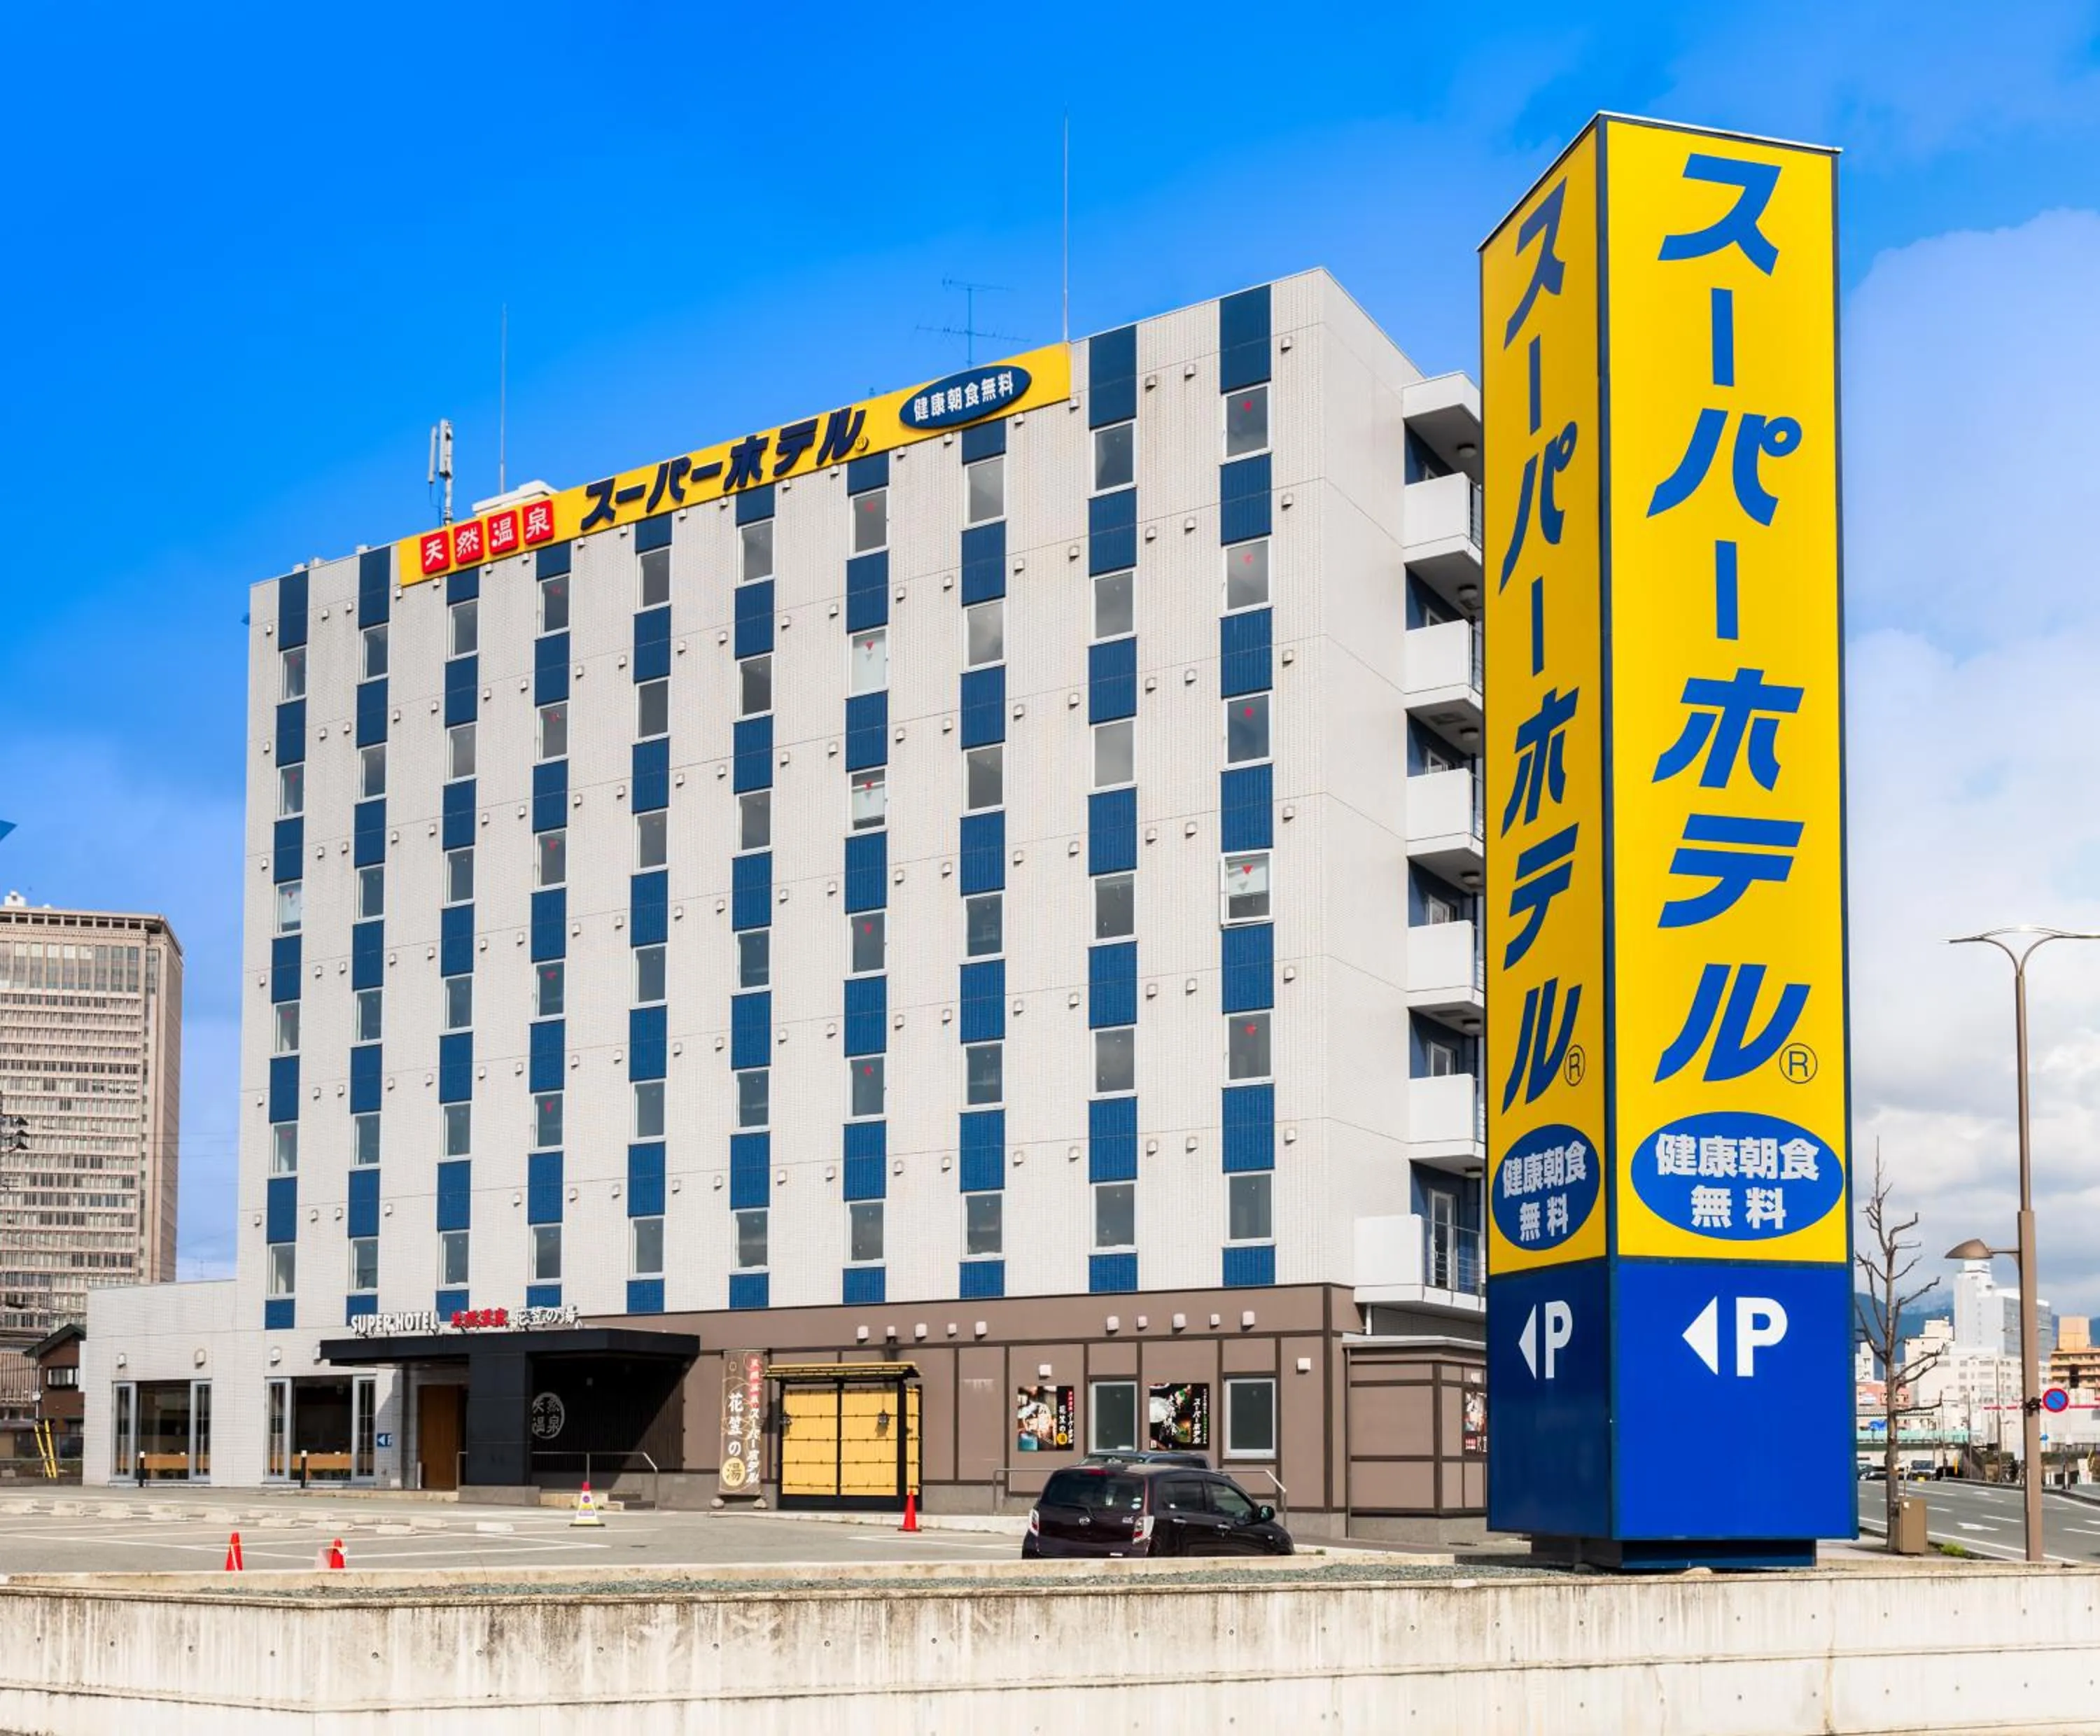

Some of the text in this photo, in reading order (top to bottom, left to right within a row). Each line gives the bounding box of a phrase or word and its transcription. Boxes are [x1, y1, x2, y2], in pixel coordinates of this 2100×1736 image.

[913, 370, 1014, 422] 健康朝食無料
[580, 406, 867, 531] スーパーホテル
[424, 506, 551, 567] 天然温泉
[1499, 176, 1583, 1116] スーパーホテル
[1646, 153, 1812, 1084] スーパーホテル
[1502, 1140, 1588, 1199] 健康朝食
[1656, 1133, 1820, 1182] 健康朝食
[1519, 1194, 1569, 1242] 無料
[1690, 1185, 1787, 1230] 無料
[351, 1311, 439, 1334] SUPER HOTEL
[1545, 1300, 1573, 1379] P
[1736, 1296, 1788, 1377] P
